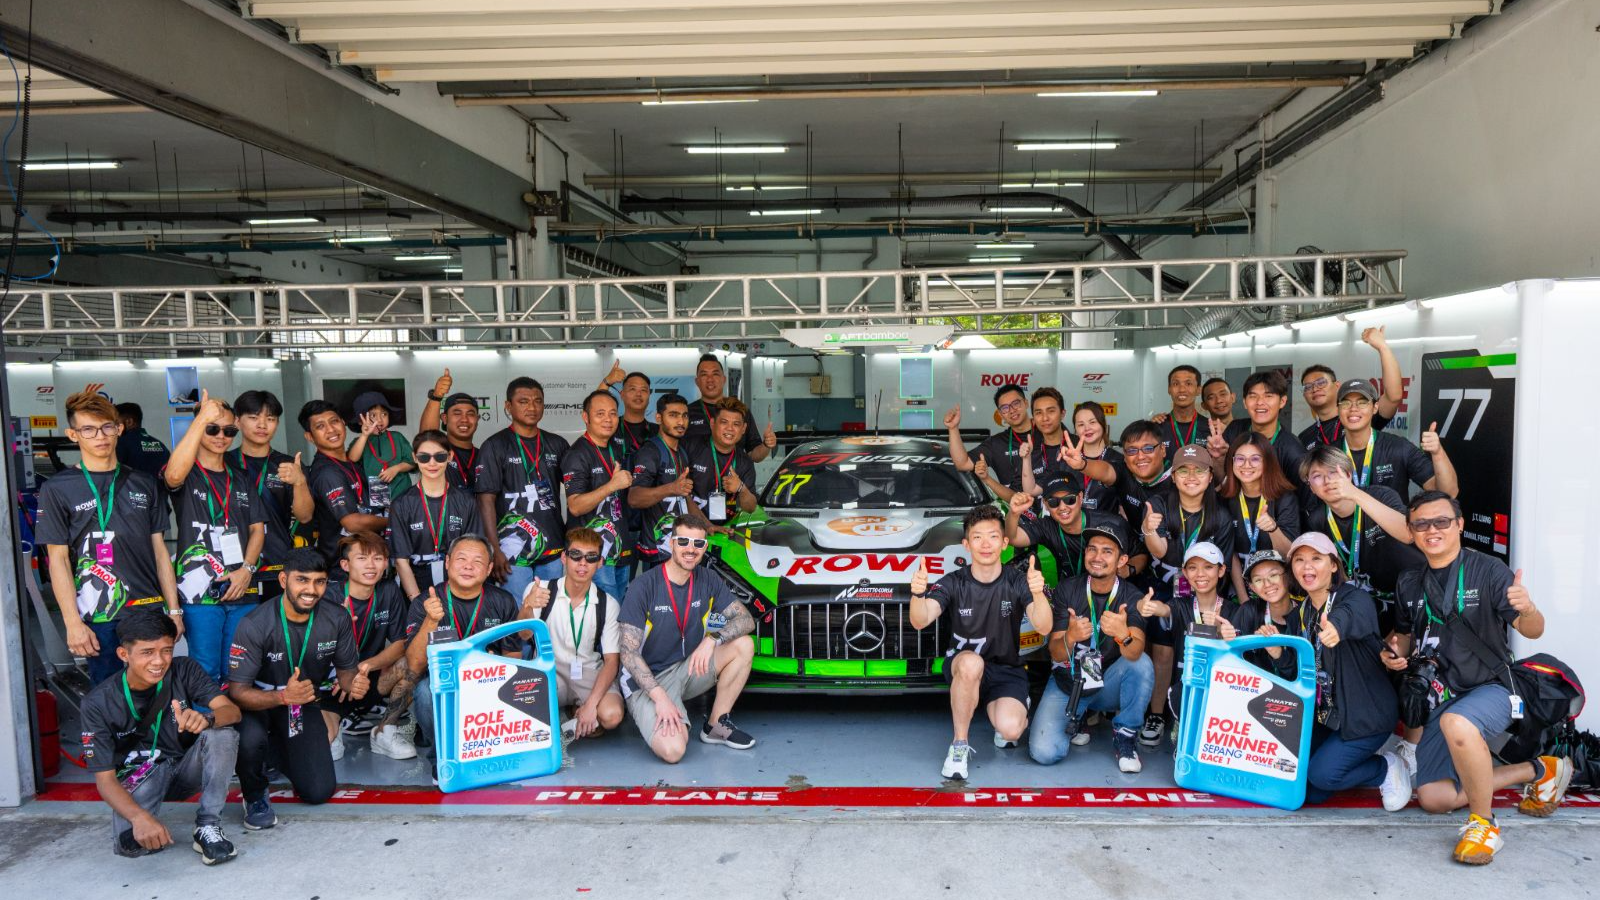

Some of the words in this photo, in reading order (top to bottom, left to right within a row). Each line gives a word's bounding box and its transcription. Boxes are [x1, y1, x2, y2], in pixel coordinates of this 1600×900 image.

[980, 374, 1030, 386] ROWE
[1396, 416, 1408, 430] OIL
[1438, 388, 1492, 441] 77
[774, 474, 812, 496] 77
[518, 518, 538, 536] ROWE
[786, 554, 944, 576] ROWE
[953, 632, 986, 654] 77
[462, 665, 506, 682] ROWE
[1214, 670, 1262, 688] ROWE
[1265, 698, 1298, 706] FANATEC
[464, 710, 504, 728] POLE
[1208, 716, 1251, 736] POLE
[464, 720, 532, 741] WINNER
[504, 734, 529, 744] ROWE
[462, 738, 500, 751] SEPANG
[1202, 744, 1242, 758] SEPANG
[1206, 730, 1278, 756] WINNER
[462, 750, 484, 760] RACE
[1200, 753, 1223, 764] RACE
[1246, 754, 1274, 765] ROWE
[478, 759, 522, 776] ROWE
[536, 792, 616, 800] PIT
[653, 792, 780, 800] LANE
[964, 792, 1042, 802] PIT
[1083, 792, 1216, 802] LANE
